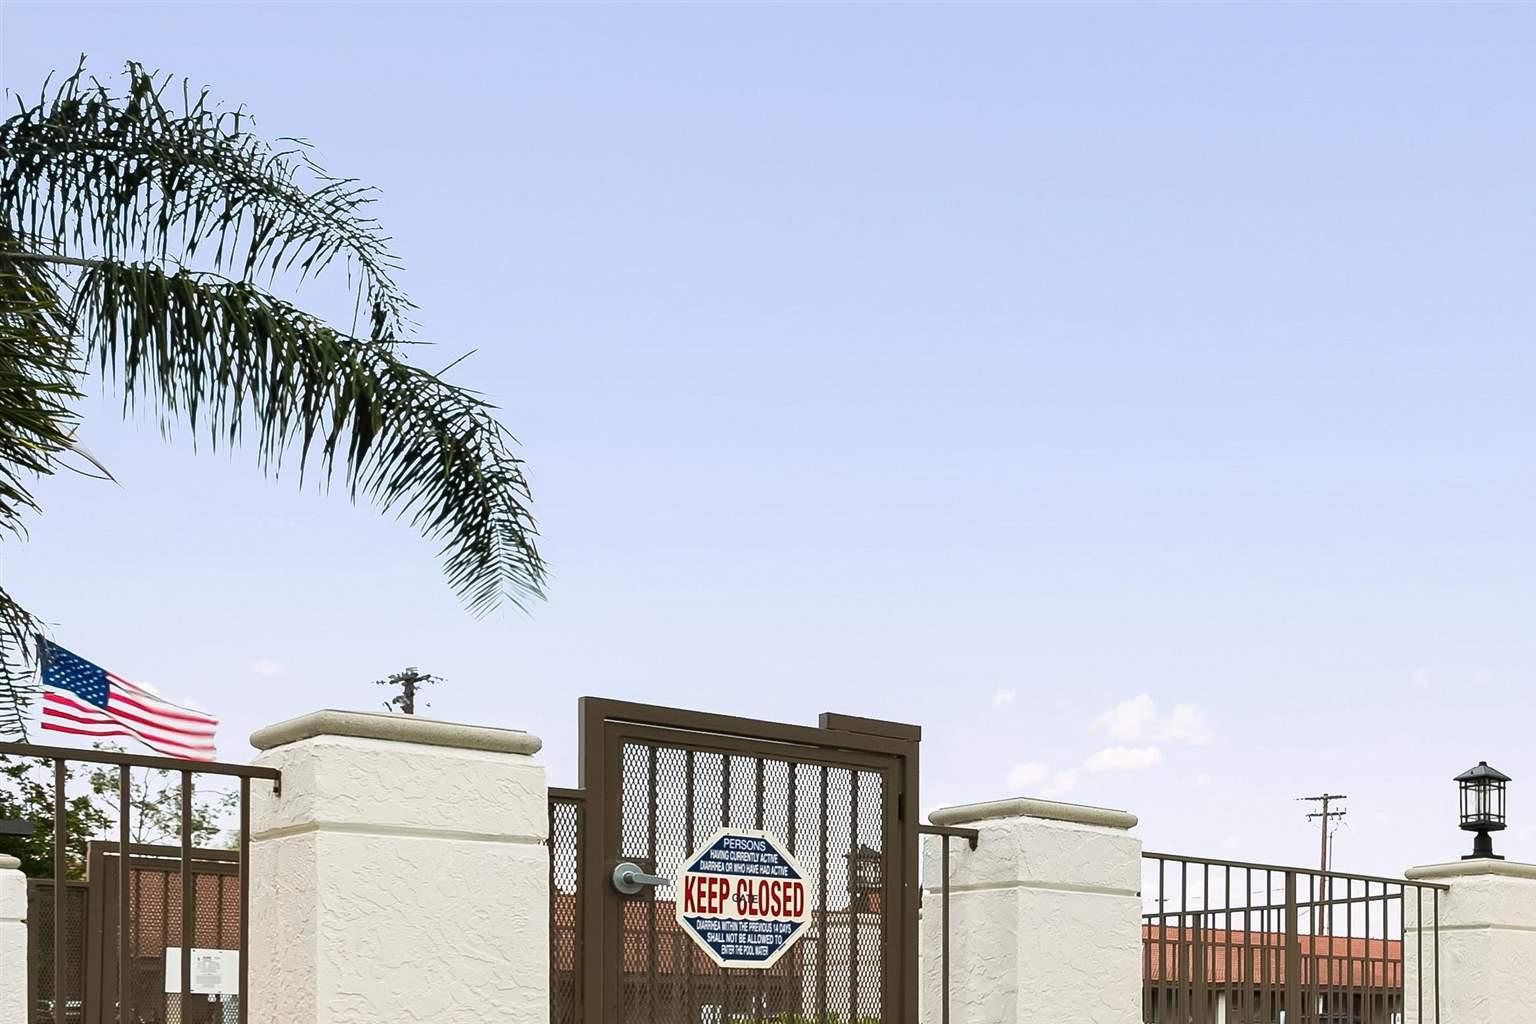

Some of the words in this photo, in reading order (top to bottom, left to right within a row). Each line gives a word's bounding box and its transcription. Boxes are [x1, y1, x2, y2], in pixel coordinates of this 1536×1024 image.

[723, 838, 766, 851] PERSONS
[710, 849, 729, 860] HAVING
[730, 850, 759, 862] CURRENTLY
[760, 853, 778, 864] ACTIVE
[700, 860, 724, 872] DIARRHEA
[725, 862, 733, 872] OR
[734, 863, 745, 874] WHO
[746, 864, 759, 874] HAVE
[760, 865, 770, 875] HAD
[771, 865, 788, 876] ACTIVE
[684, 875, 730, 914] KEEP
[737, 879, 804, 917] CLOSED
[732, 893, 758, 904] GATE
[697, 920, 720, 931] DIARRHEA
[721, 921, 738, 931] WITHIN
[739, 921, 748, 932] THE
[749, 922, 772, 933] PREVIOUS
[773, 923, 779, 933] 14
[779, 923, 791, 934] DAYS
[707, 932, 725, 942] SHALL
[726, 933, 738, 943] NOT
[739, 933, 747, 943] BE
[747, 934, 774, 944] ALLOWED
[775, 935, 782, 944] TO
[735, 945, 743, 955] THE
[744, 945, 754, 955] POOL
